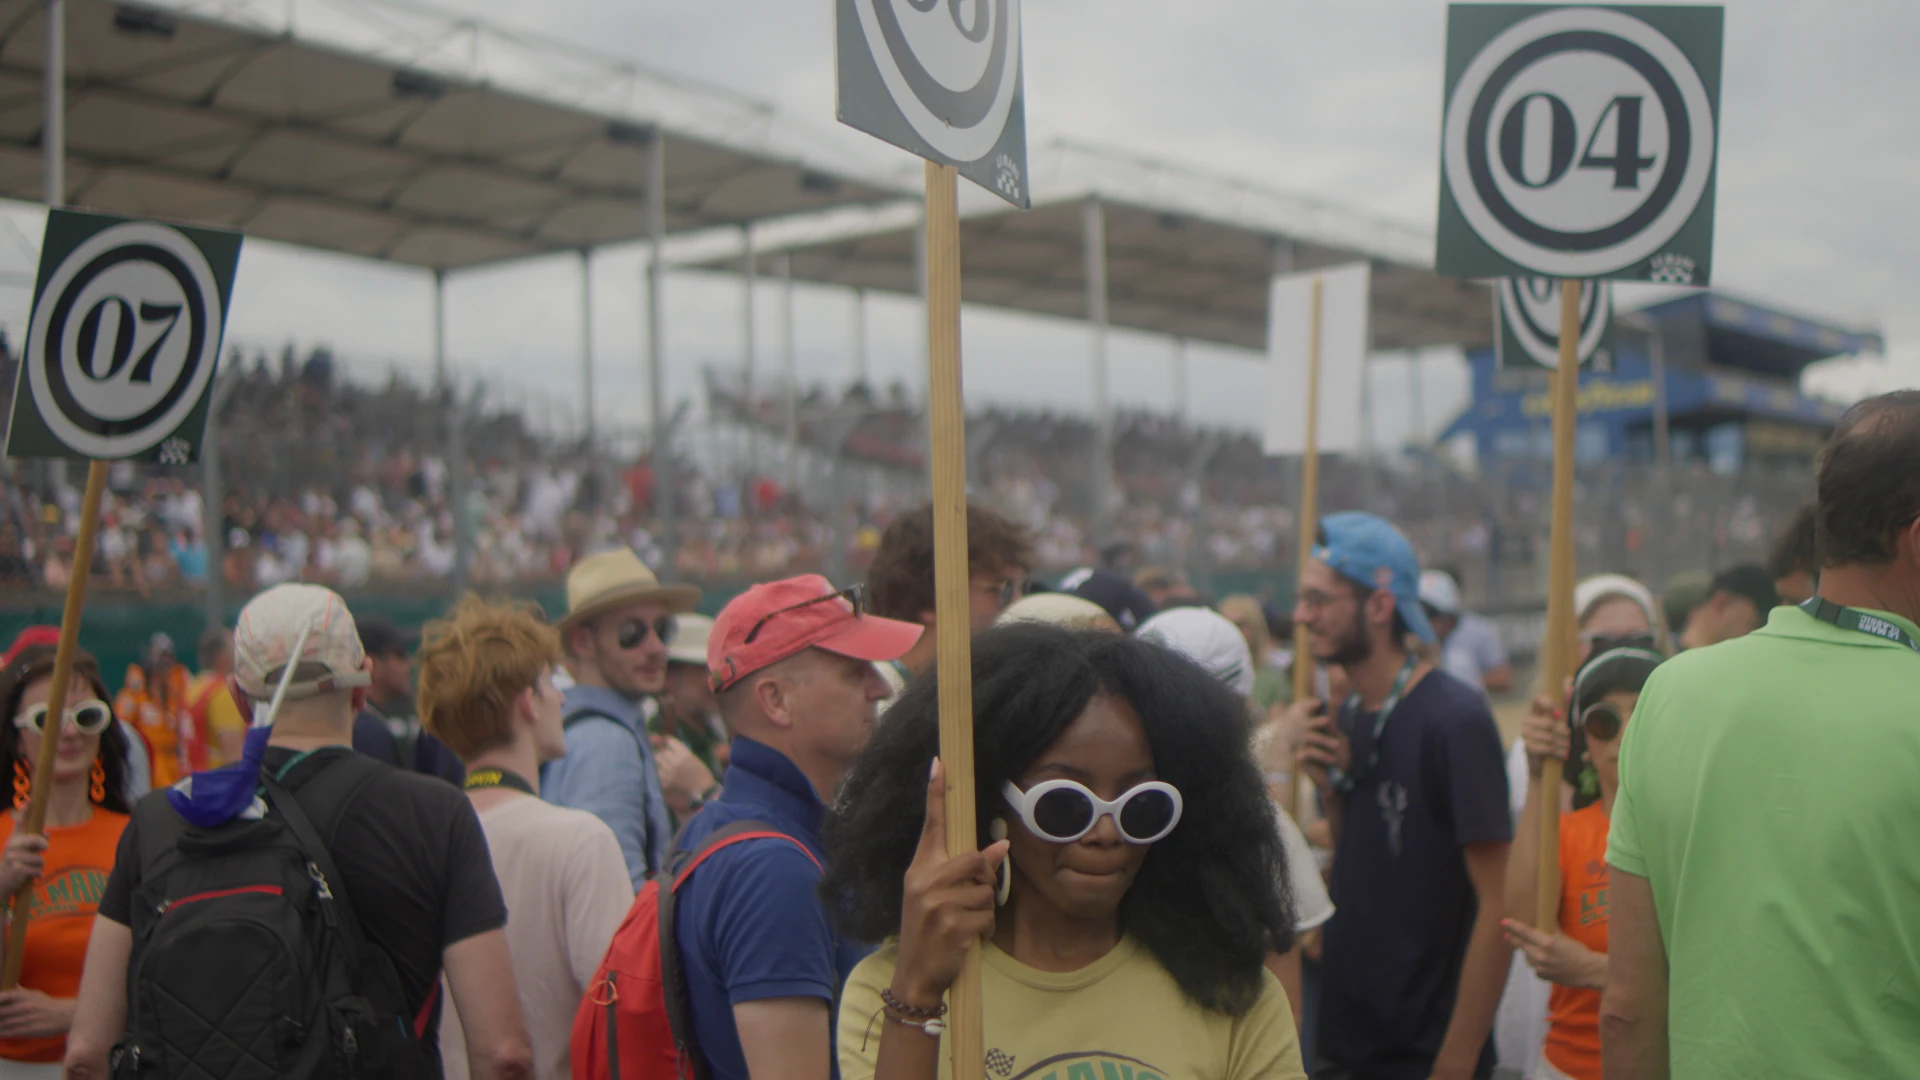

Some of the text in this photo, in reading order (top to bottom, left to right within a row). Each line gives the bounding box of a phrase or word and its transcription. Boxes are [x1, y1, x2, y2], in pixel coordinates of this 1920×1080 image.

[1499, 91, 1657, 189] 04
[76, 296, 183, 383] 07
[47, 870, 109, 903] MAN
